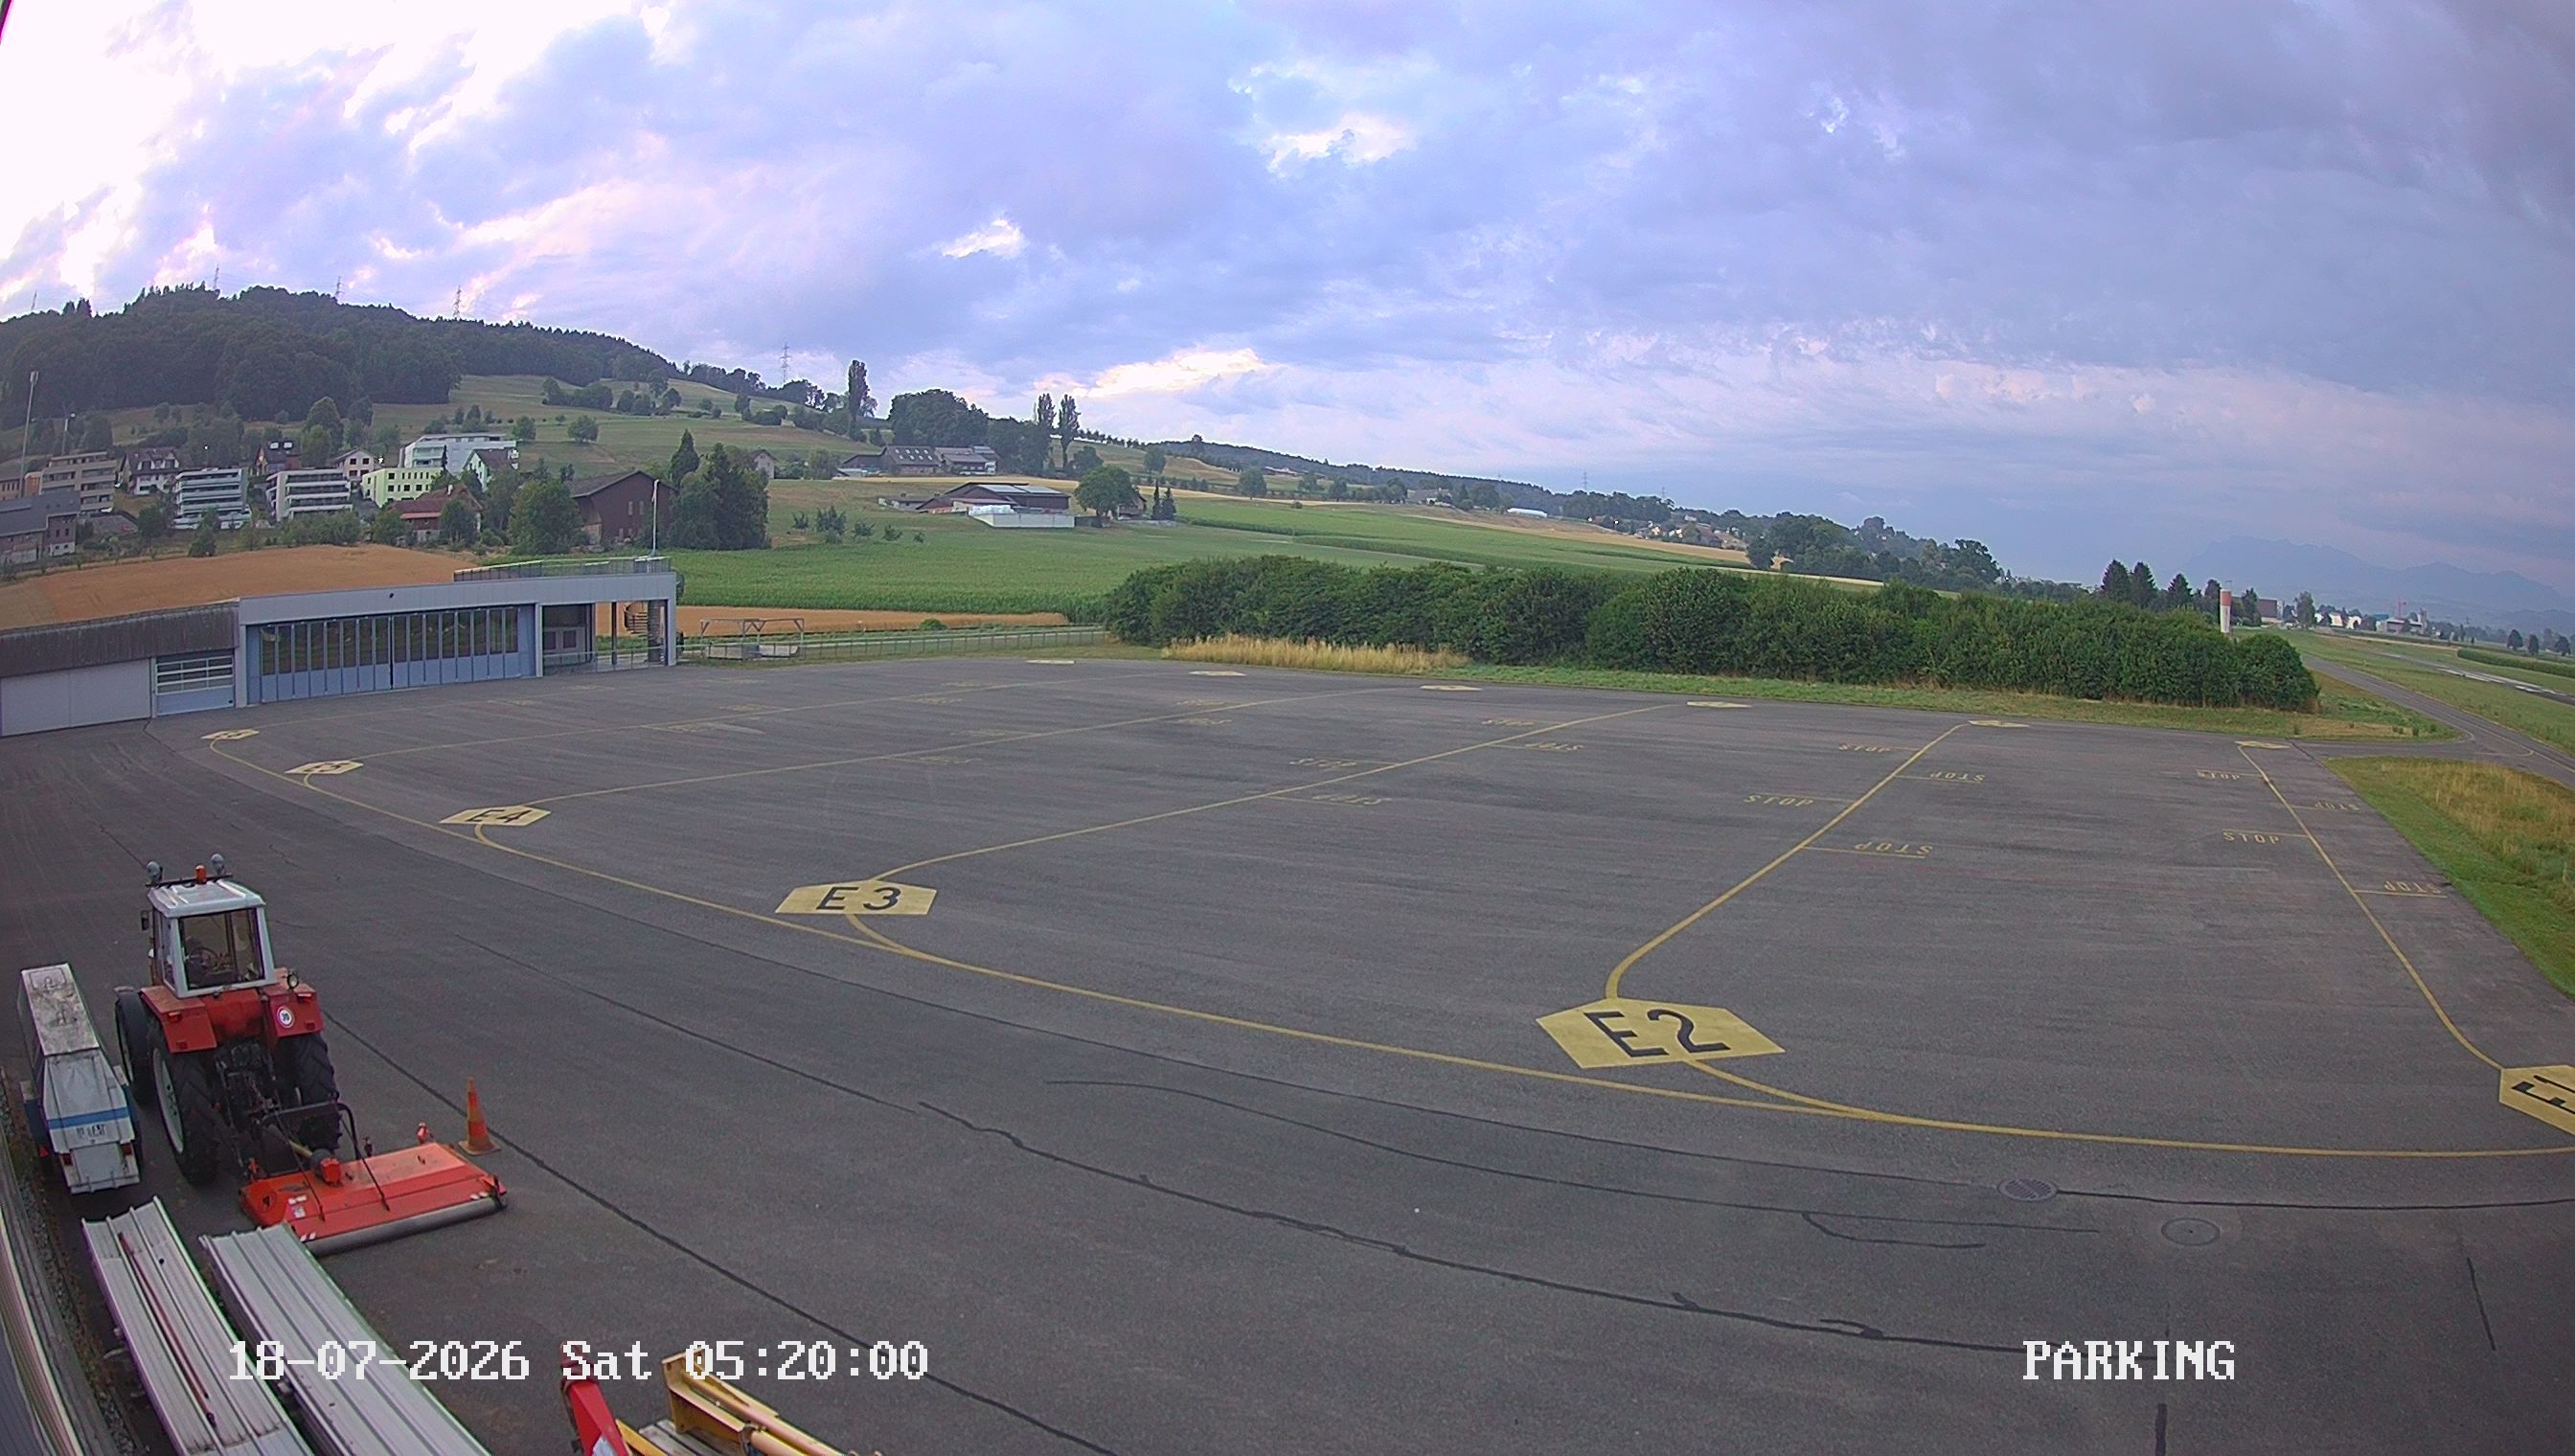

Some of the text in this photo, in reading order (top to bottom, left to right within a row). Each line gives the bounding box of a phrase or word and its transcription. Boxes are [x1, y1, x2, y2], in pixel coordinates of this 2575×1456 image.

[1838, 742, 1892, 753] STOP
[1929, 771, 1986, 782] STOP
[2197, 771, 2241, 781] STOP
[1744, 793, 1814, 807] STOP
[2314, 800, 2360, 811] STOP
[467, 808, 526, 824] E4
[2222, 830, 2280, 845] STOP
[1855, 841, 1934, 855] STOP
[2384, 880, 2442, 894] STOP
[816, 885, 902, 911] E3
[1583, 1009, 1731, 1058] E2
